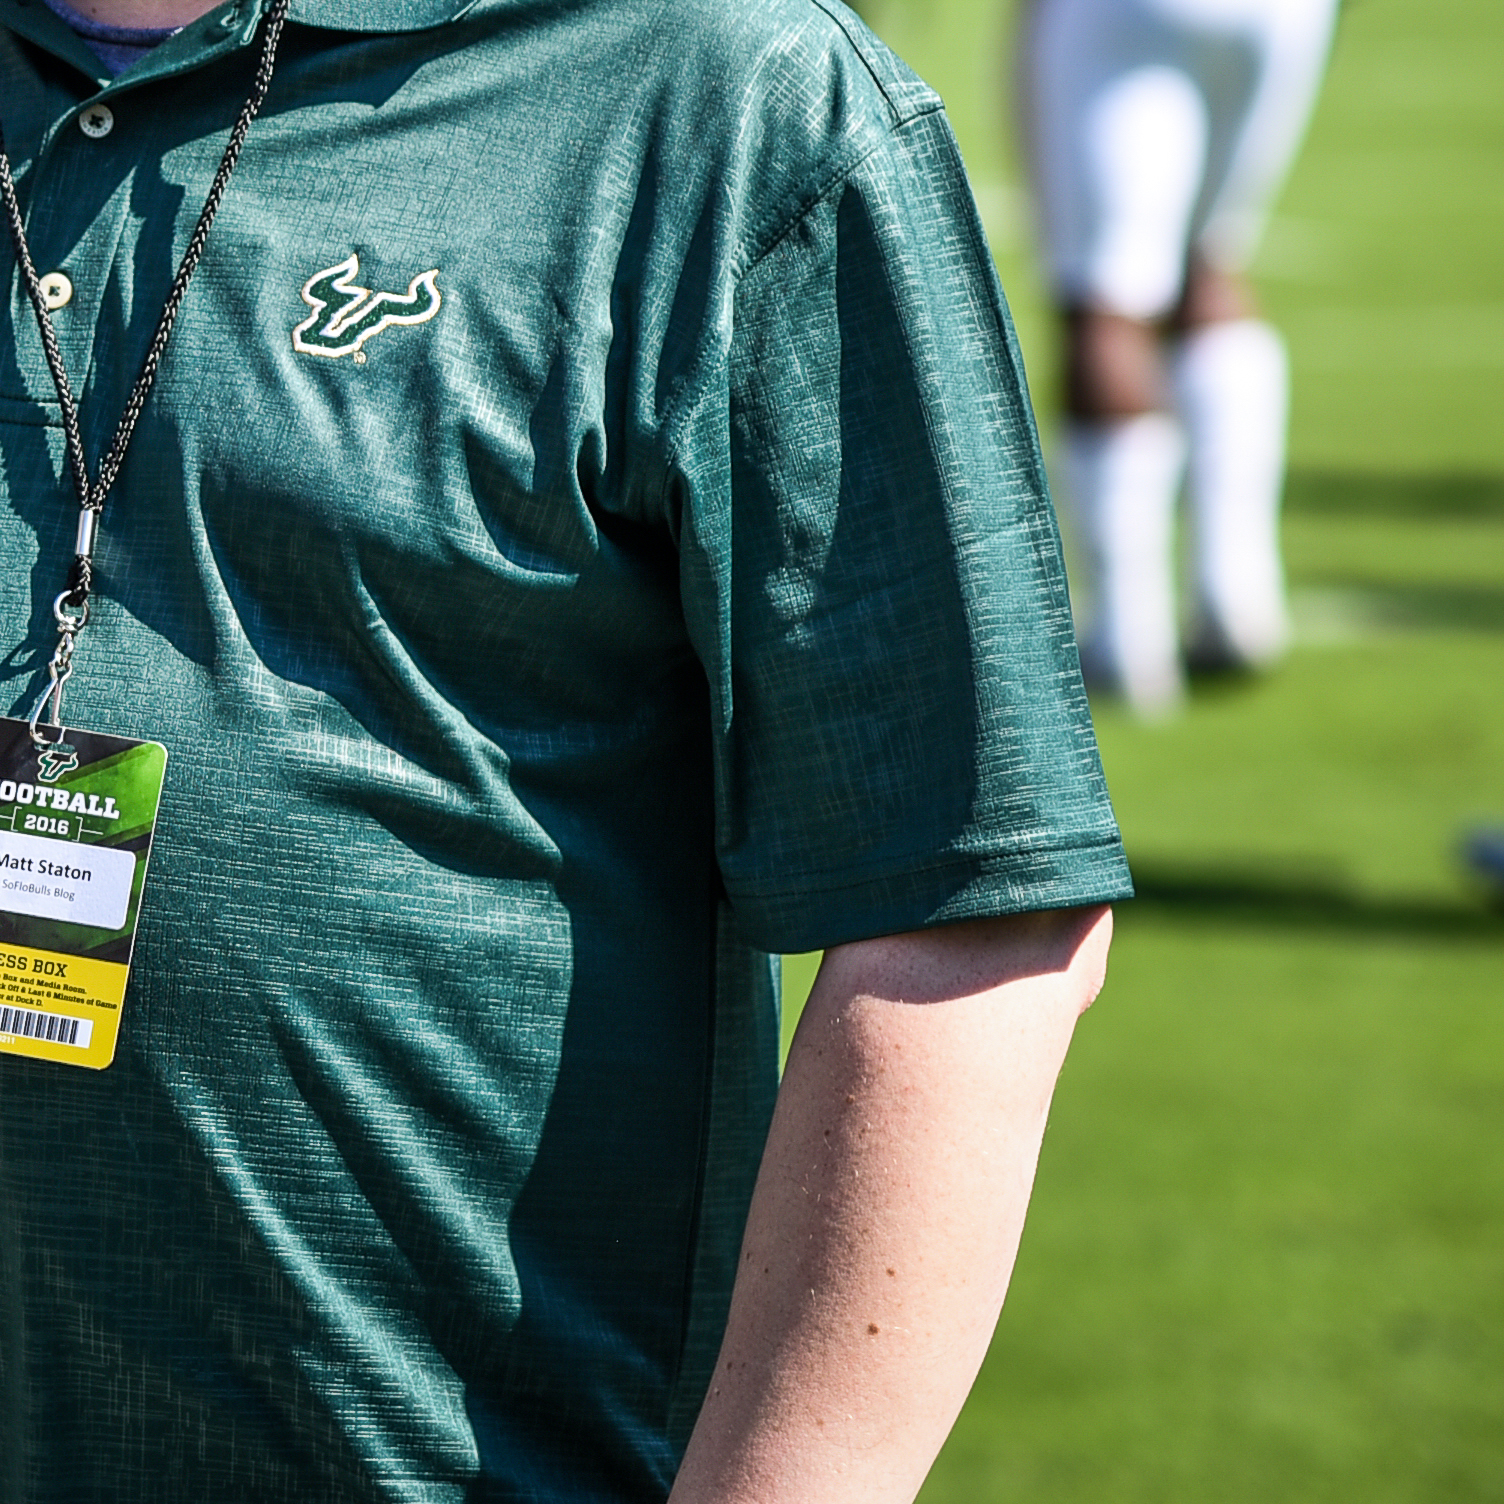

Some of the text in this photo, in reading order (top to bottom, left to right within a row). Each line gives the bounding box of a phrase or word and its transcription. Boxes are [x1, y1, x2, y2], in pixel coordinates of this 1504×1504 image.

[23, 813, 70, 835] 2016
[37, 859, 92, 881] Staton
[2, 878, 75, 902] SoFloBulls Blog
[32, 959, 68, 977] BOX
[3, 973, 18, 982] Box
[19, 976, 35, 985] and
[36, 979, 61, 990] Media
[63, 983, 87, 994] Room.
[5, 994, 14, 1002] at
[15, 995, 34, 1005] Dock
[7, 984, 20, 993] Off
[28, 987, 45, 997] Last
[53, 992, 85, 1004] Minutes
[86, 998, 94, 1006] of
[95, 999, 118, 1010] Game
